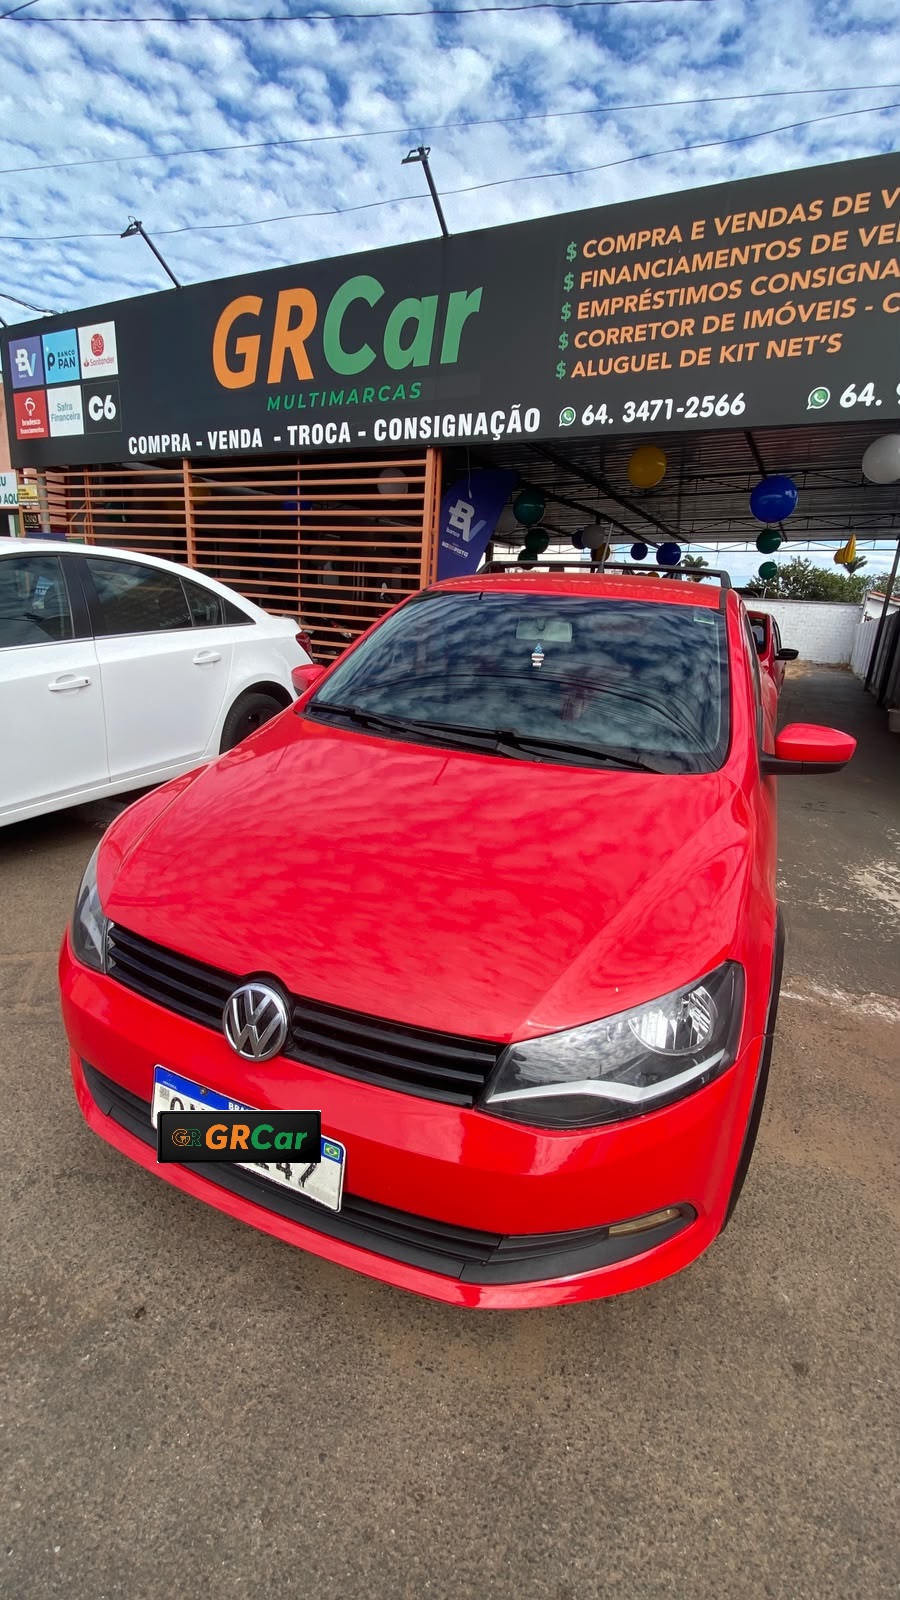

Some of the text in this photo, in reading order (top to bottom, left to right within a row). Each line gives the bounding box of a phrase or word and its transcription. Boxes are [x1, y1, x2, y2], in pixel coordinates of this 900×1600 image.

[582, 225, 682, 258] COMPRA
[691, 220, 705, 240] E
[714, 200, 823, 235] VENDAS
[832, 192, 871, 217] DE
[580, 237, 802, 288] FINANCIAMENTOS
[811, 230, 848, 254] DE
[859, 223, 900, 247] VE
[577, 280, 742, 319] EMPRÉSTIMOS
[751, 258, 900, 295] CONSIGNA
[213, 275, 482, 390] GRCar
[574, 315, 694, 348] CORRETOR
[702, 313, 735, 334] DE
[744, 298, 857, 329] IMÓVEIS
[58, 357, 76, 369] PAN
[90, 357, 114, 367] Santander
[570, 352, 672, 378] ALUGUEL
[680, 347, 711, 367] DE
[719, 342, 759, 363] KIT
[56, 403, 73, 412] Safra
[88, 395, 116, 421] C6
[267, 382, 422, 411] MULTIMARCAS
[581, 393, 746, 426] 64. 3471-2566
[839, 381, 883, 409] 64.
[51, 412, 80, 422] Financeira
[128, 433, 191, 455] COMPRA
[208, 428, 262, 450] VENDA
[287, 422, 350, 446] TROCA
[374, 404, 541, 441] CONSIGNAÇÃO
[448, 499, 487, 542] BV
